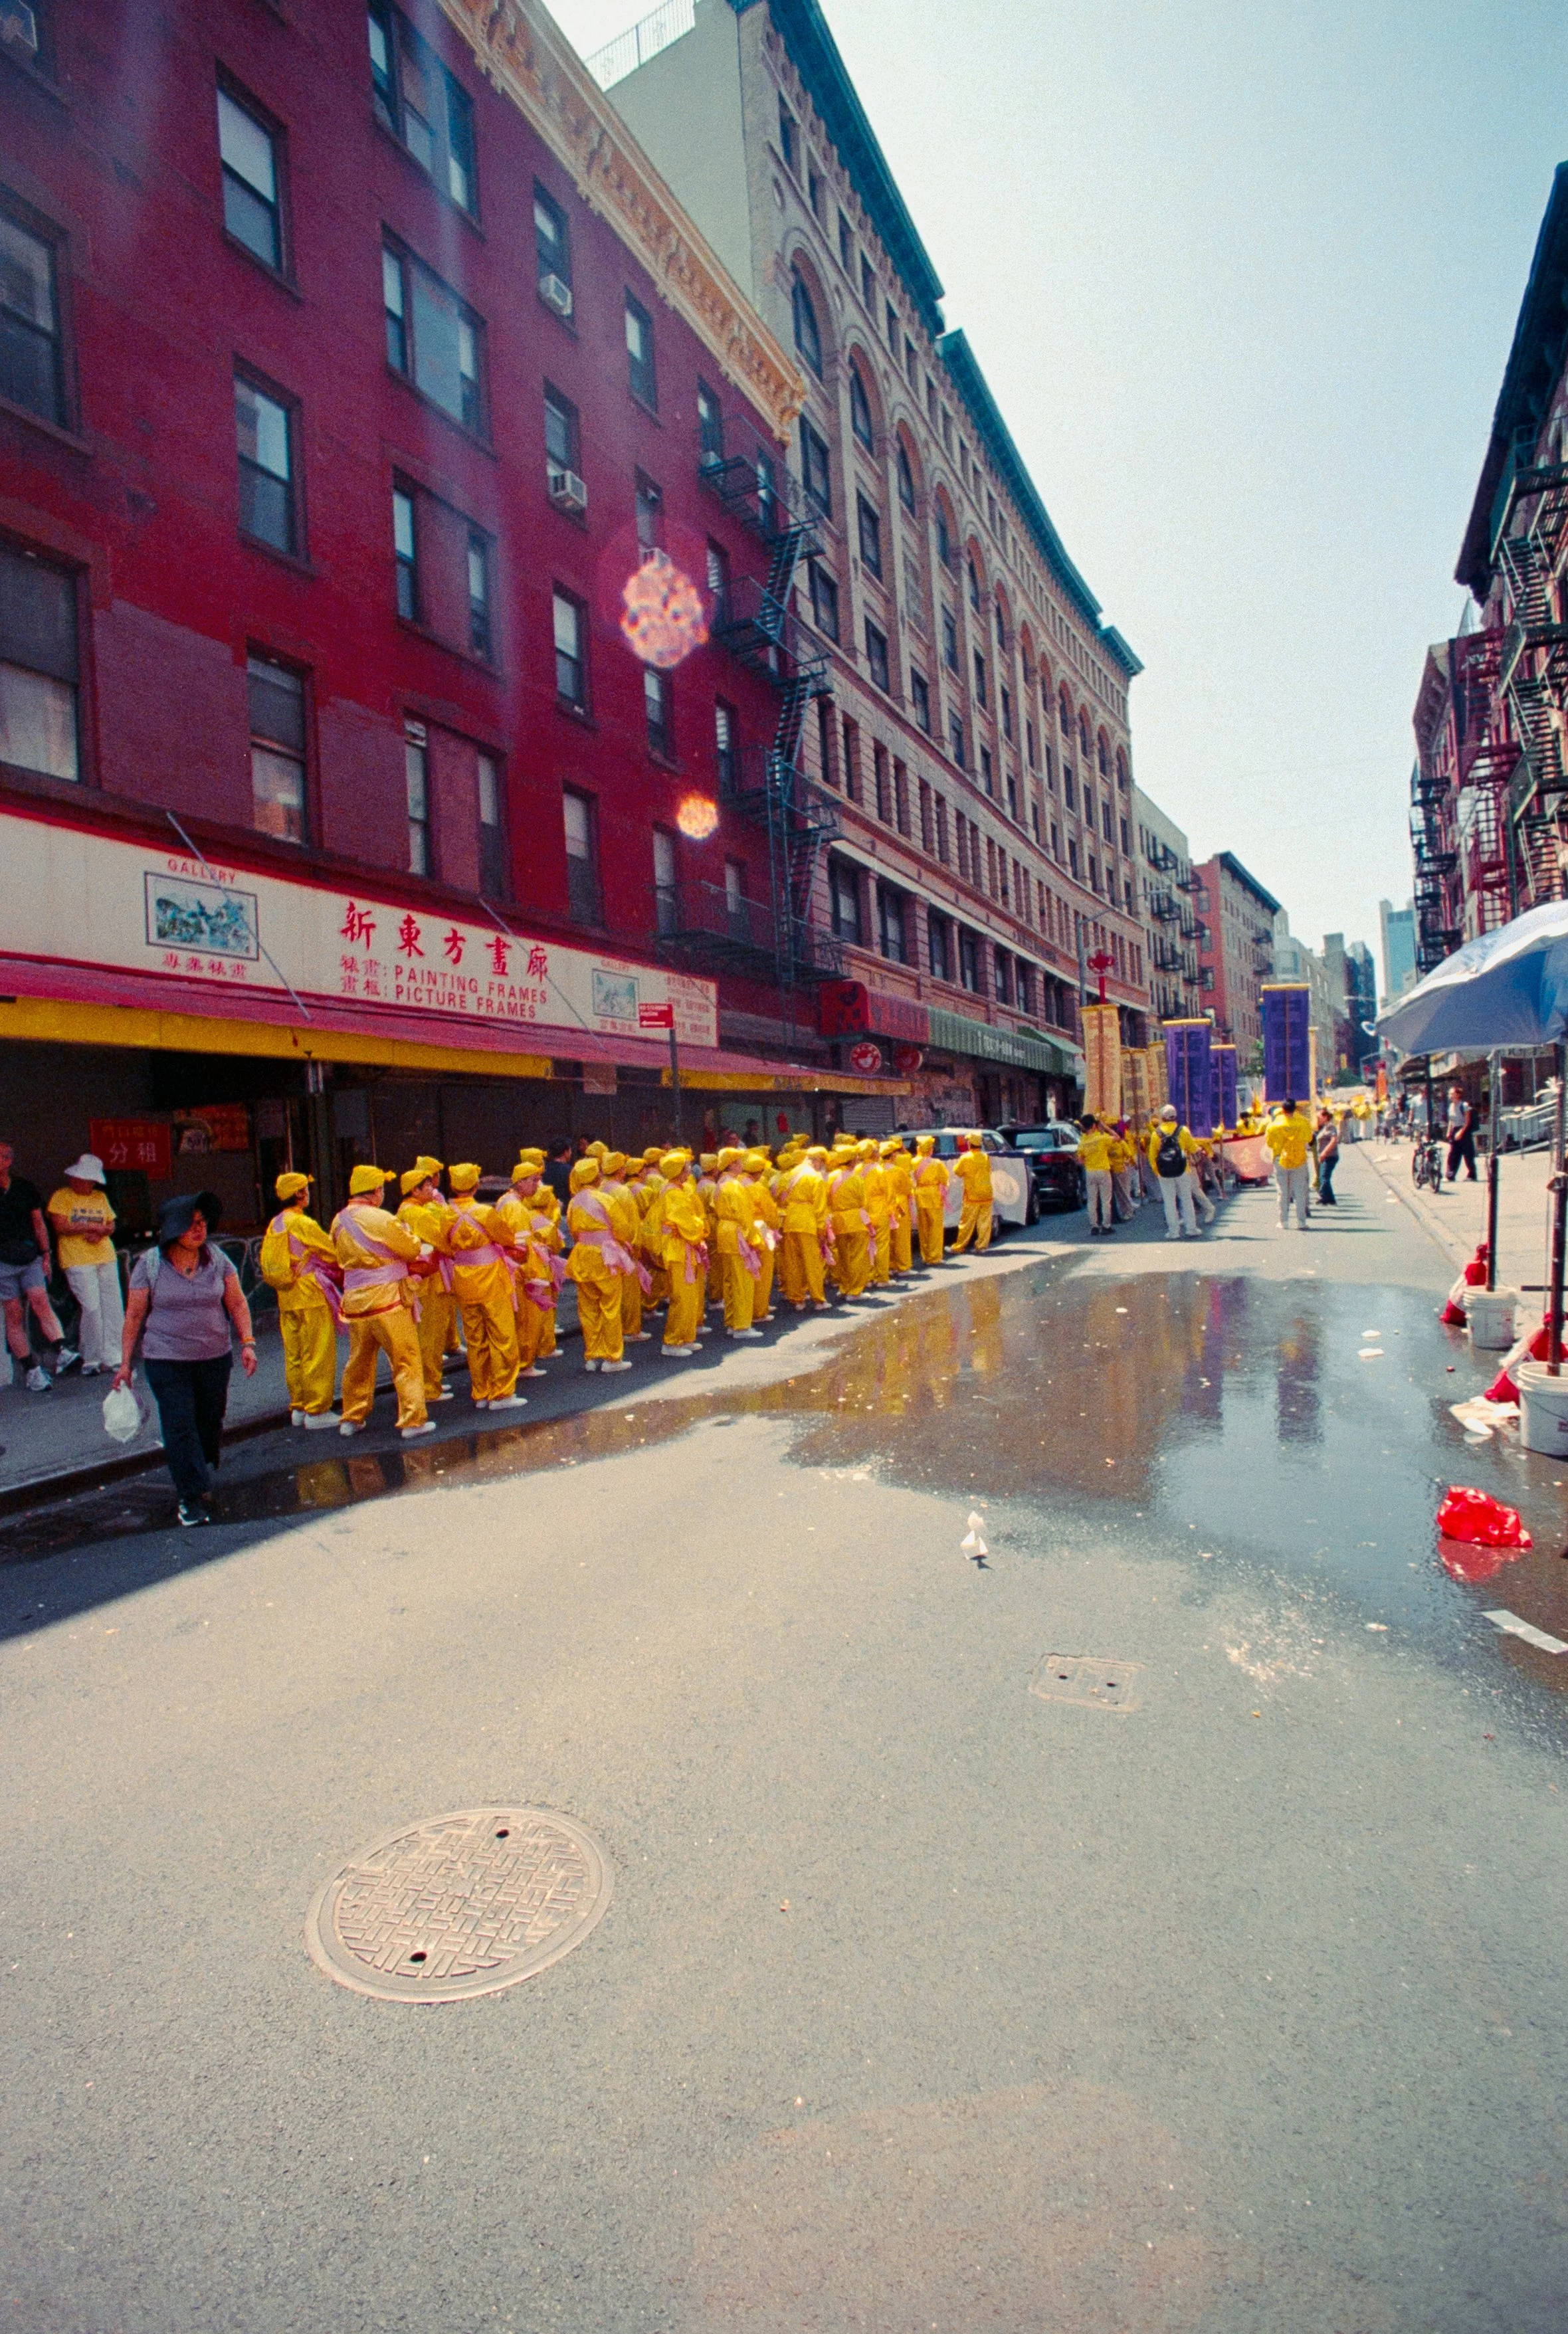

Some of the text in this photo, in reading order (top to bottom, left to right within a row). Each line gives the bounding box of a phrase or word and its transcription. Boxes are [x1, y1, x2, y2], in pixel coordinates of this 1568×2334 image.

[340, 901, 548, 983] 新東方畫廊
[394, 964, 478, 994] PAINTING
[488, 981, 547, 1005] FRAMES
[395, 984, 467, 1009] PICTURE
[476, 997, 536, 1019] FRAMES
